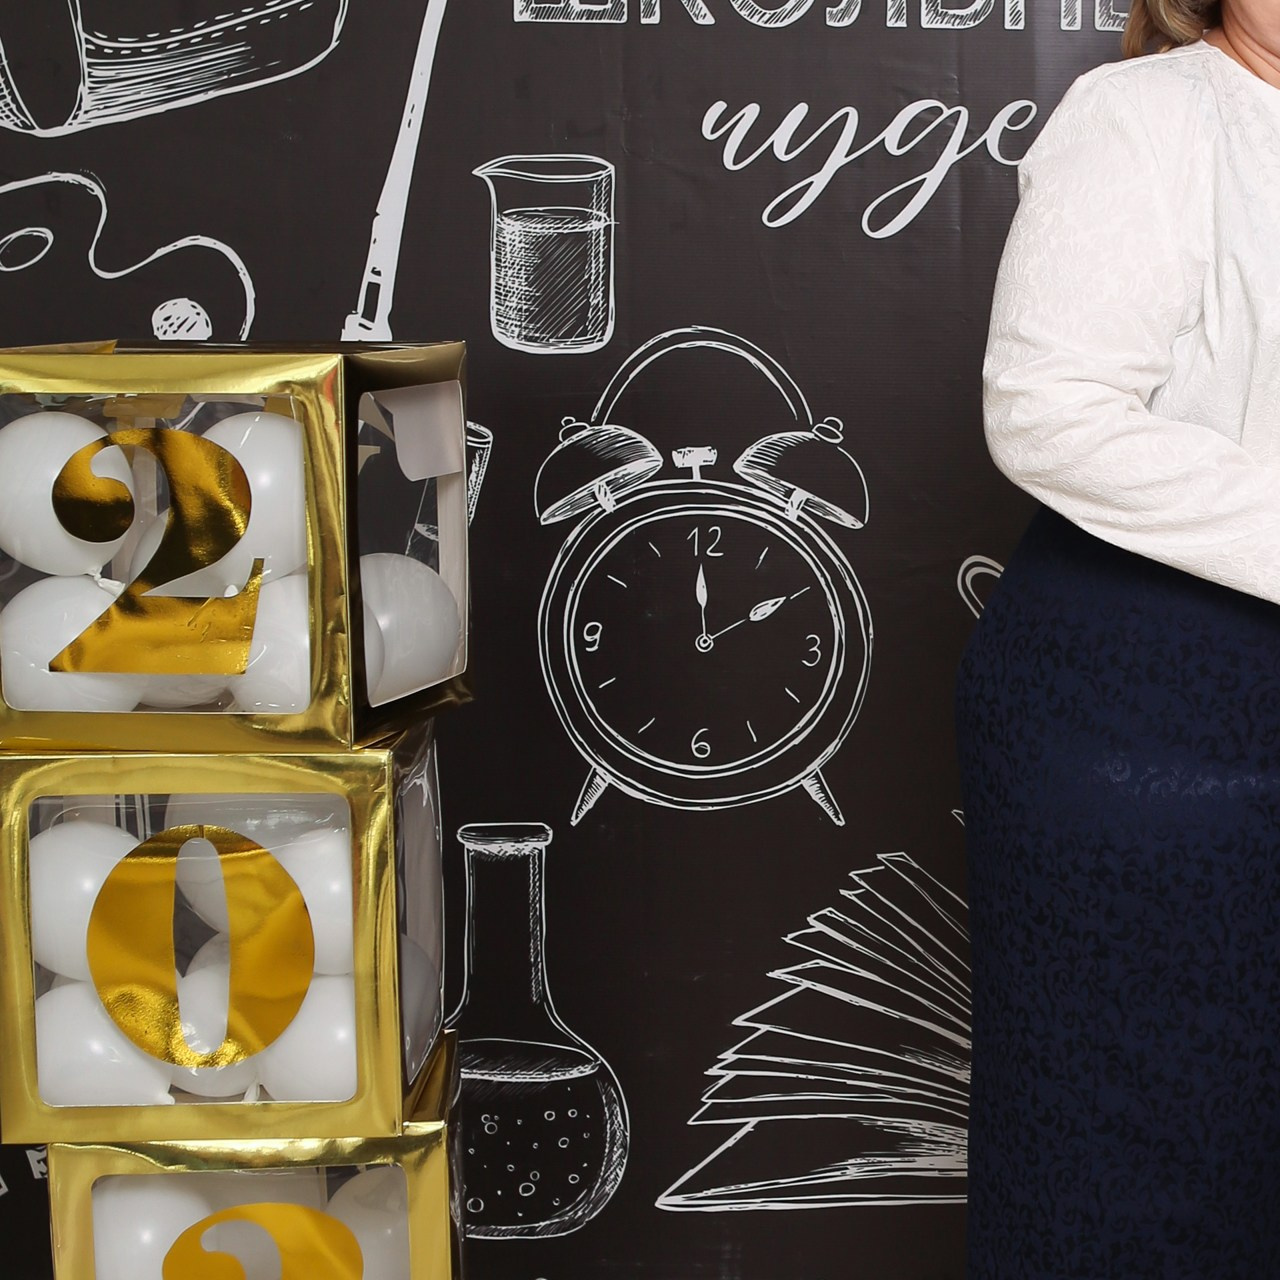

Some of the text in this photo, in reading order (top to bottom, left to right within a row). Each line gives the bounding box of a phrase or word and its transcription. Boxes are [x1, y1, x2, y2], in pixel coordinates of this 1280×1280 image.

[700, 98, 1038, 239] чуде
[687, 526, 724, 556] 12
[583, 622, 602, 651] 9
[802, 634, 822, 667] 3
[691, 728, 711, 758] 6
